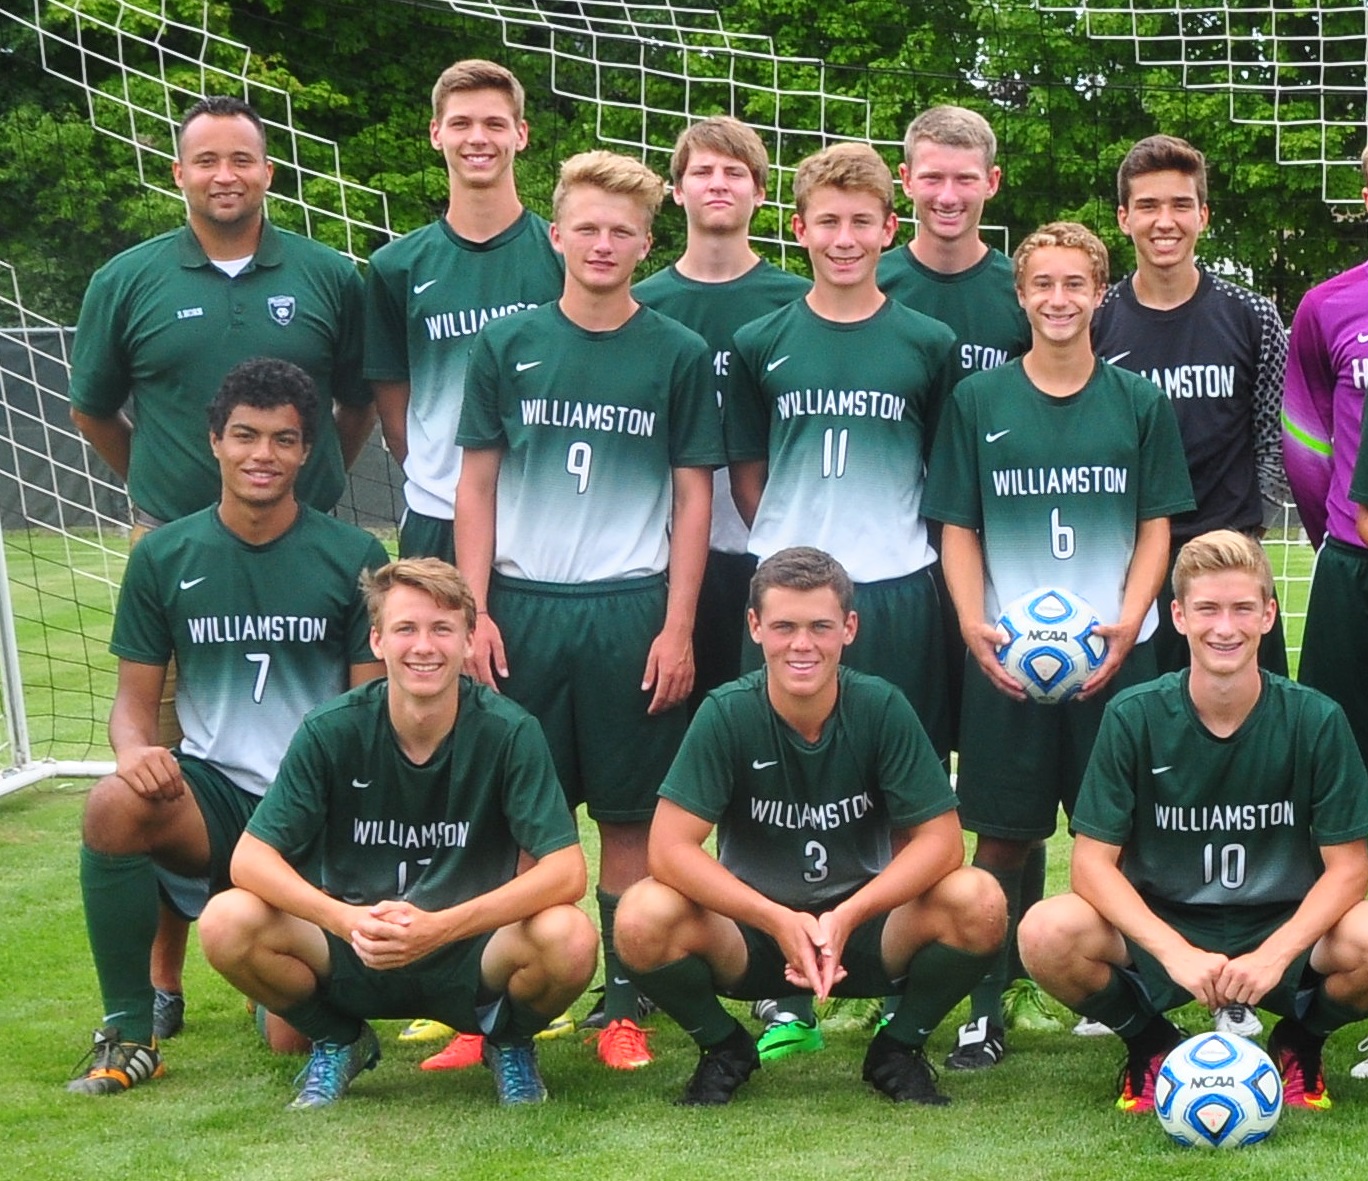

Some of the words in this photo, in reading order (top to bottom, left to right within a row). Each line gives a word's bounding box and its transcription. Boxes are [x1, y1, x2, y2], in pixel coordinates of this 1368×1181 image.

[425, 302, 539, 340] WILLIA
[521, 399, 655, 437] WILLIAMSTON
[777, 388, 906, 421] WILLIAMSTON
[566, 441, 592, 494] 9
[822, 427, 849, 478] 11
[993, 466, 1128, 496] WILLIAMSTON
[1050, 507, 1076, 560] 6
[187, 615, 327, 644] WILLIAMSTON
[1026, 629, 1068, 643] NCAA
[245, 652, 271, 704] 7
[751, 792, 873, 831] WILLIAMSTON
[1155, 801, 1294, 831] WILLIAMSTON
[353, 817, 470, 849] WILLIAMON
[803, 839, 828, 884] 3
[1203, 842, 1246, 889] 10
[1190, 1076, 1235, 1090] NCAA
